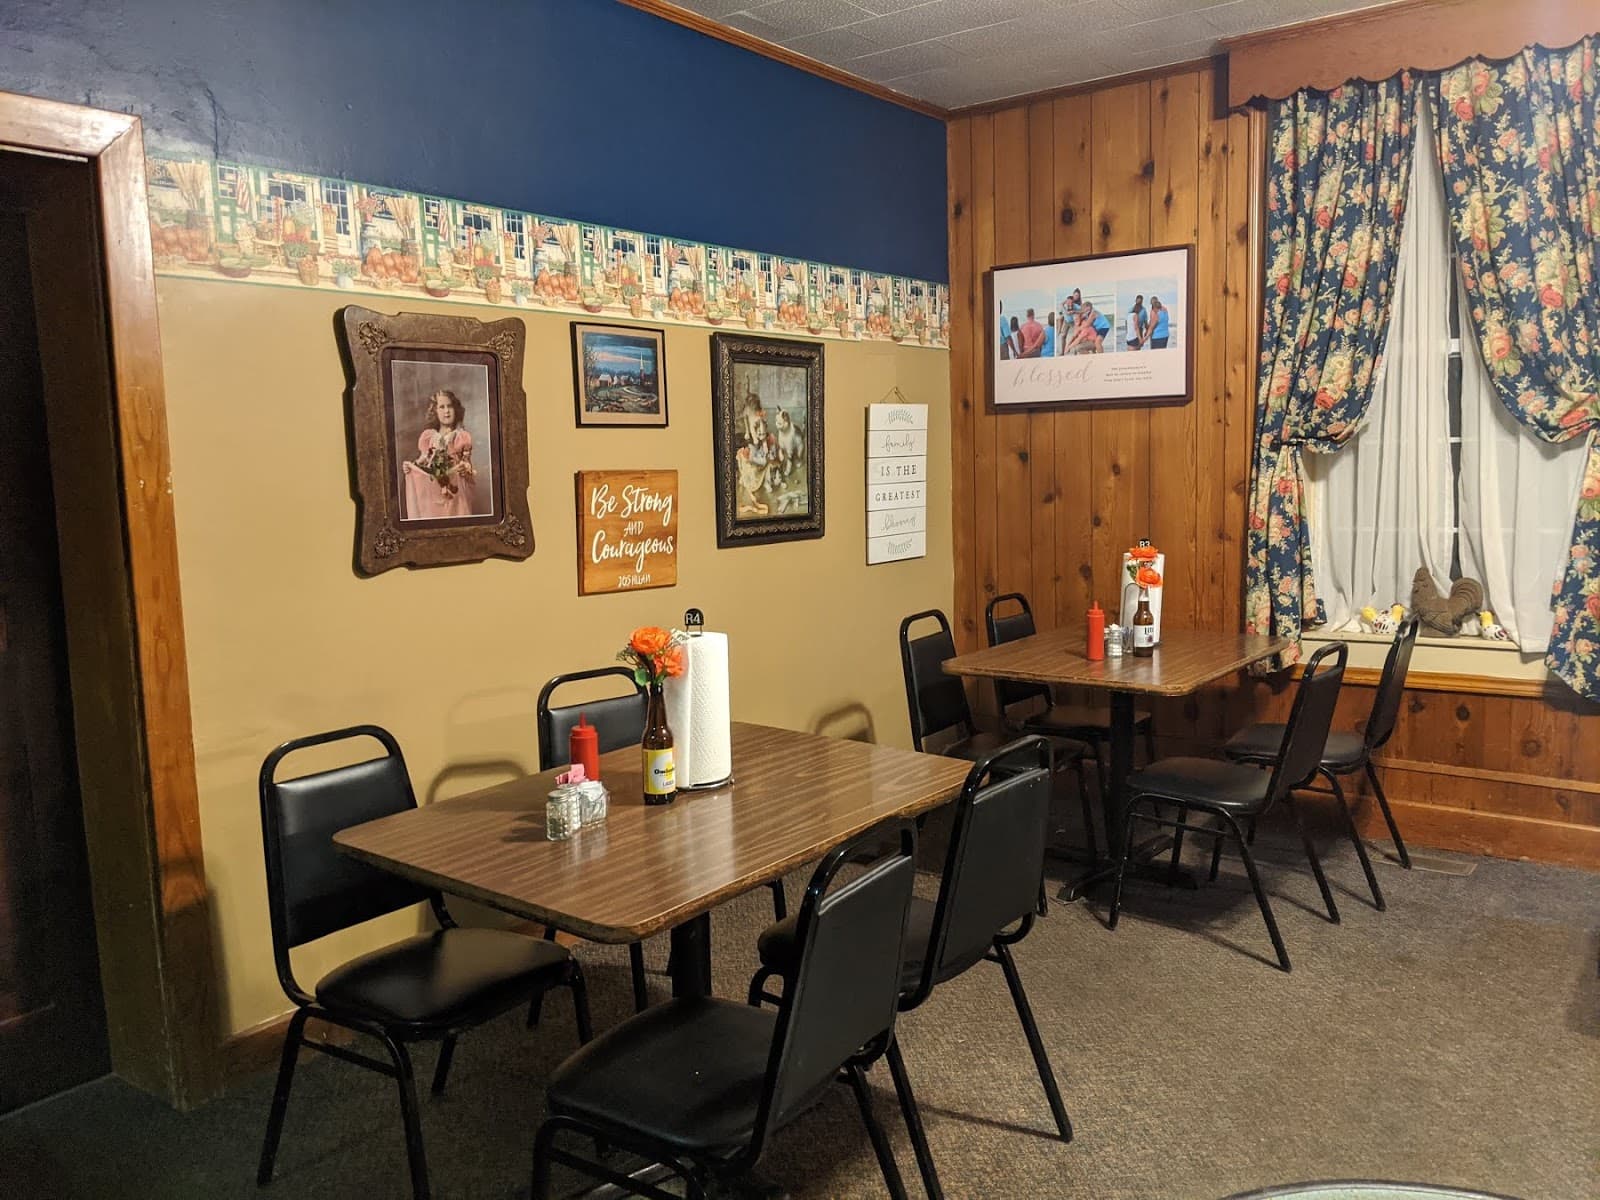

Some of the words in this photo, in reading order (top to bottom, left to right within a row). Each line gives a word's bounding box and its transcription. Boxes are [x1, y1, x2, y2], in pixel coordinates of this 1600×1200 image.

[880, 465, 891, 477] IS
[896, 464, 917, 476] THE
[874, 489, 921, 502] GREATEST
[590, 483, 618, 519] Be
[620, 484, 673, 527] Strong
[623, 520, 644, 537] AND
[591, 529, 674, 573] Courageous
[685, 612, 701, 625] R4
